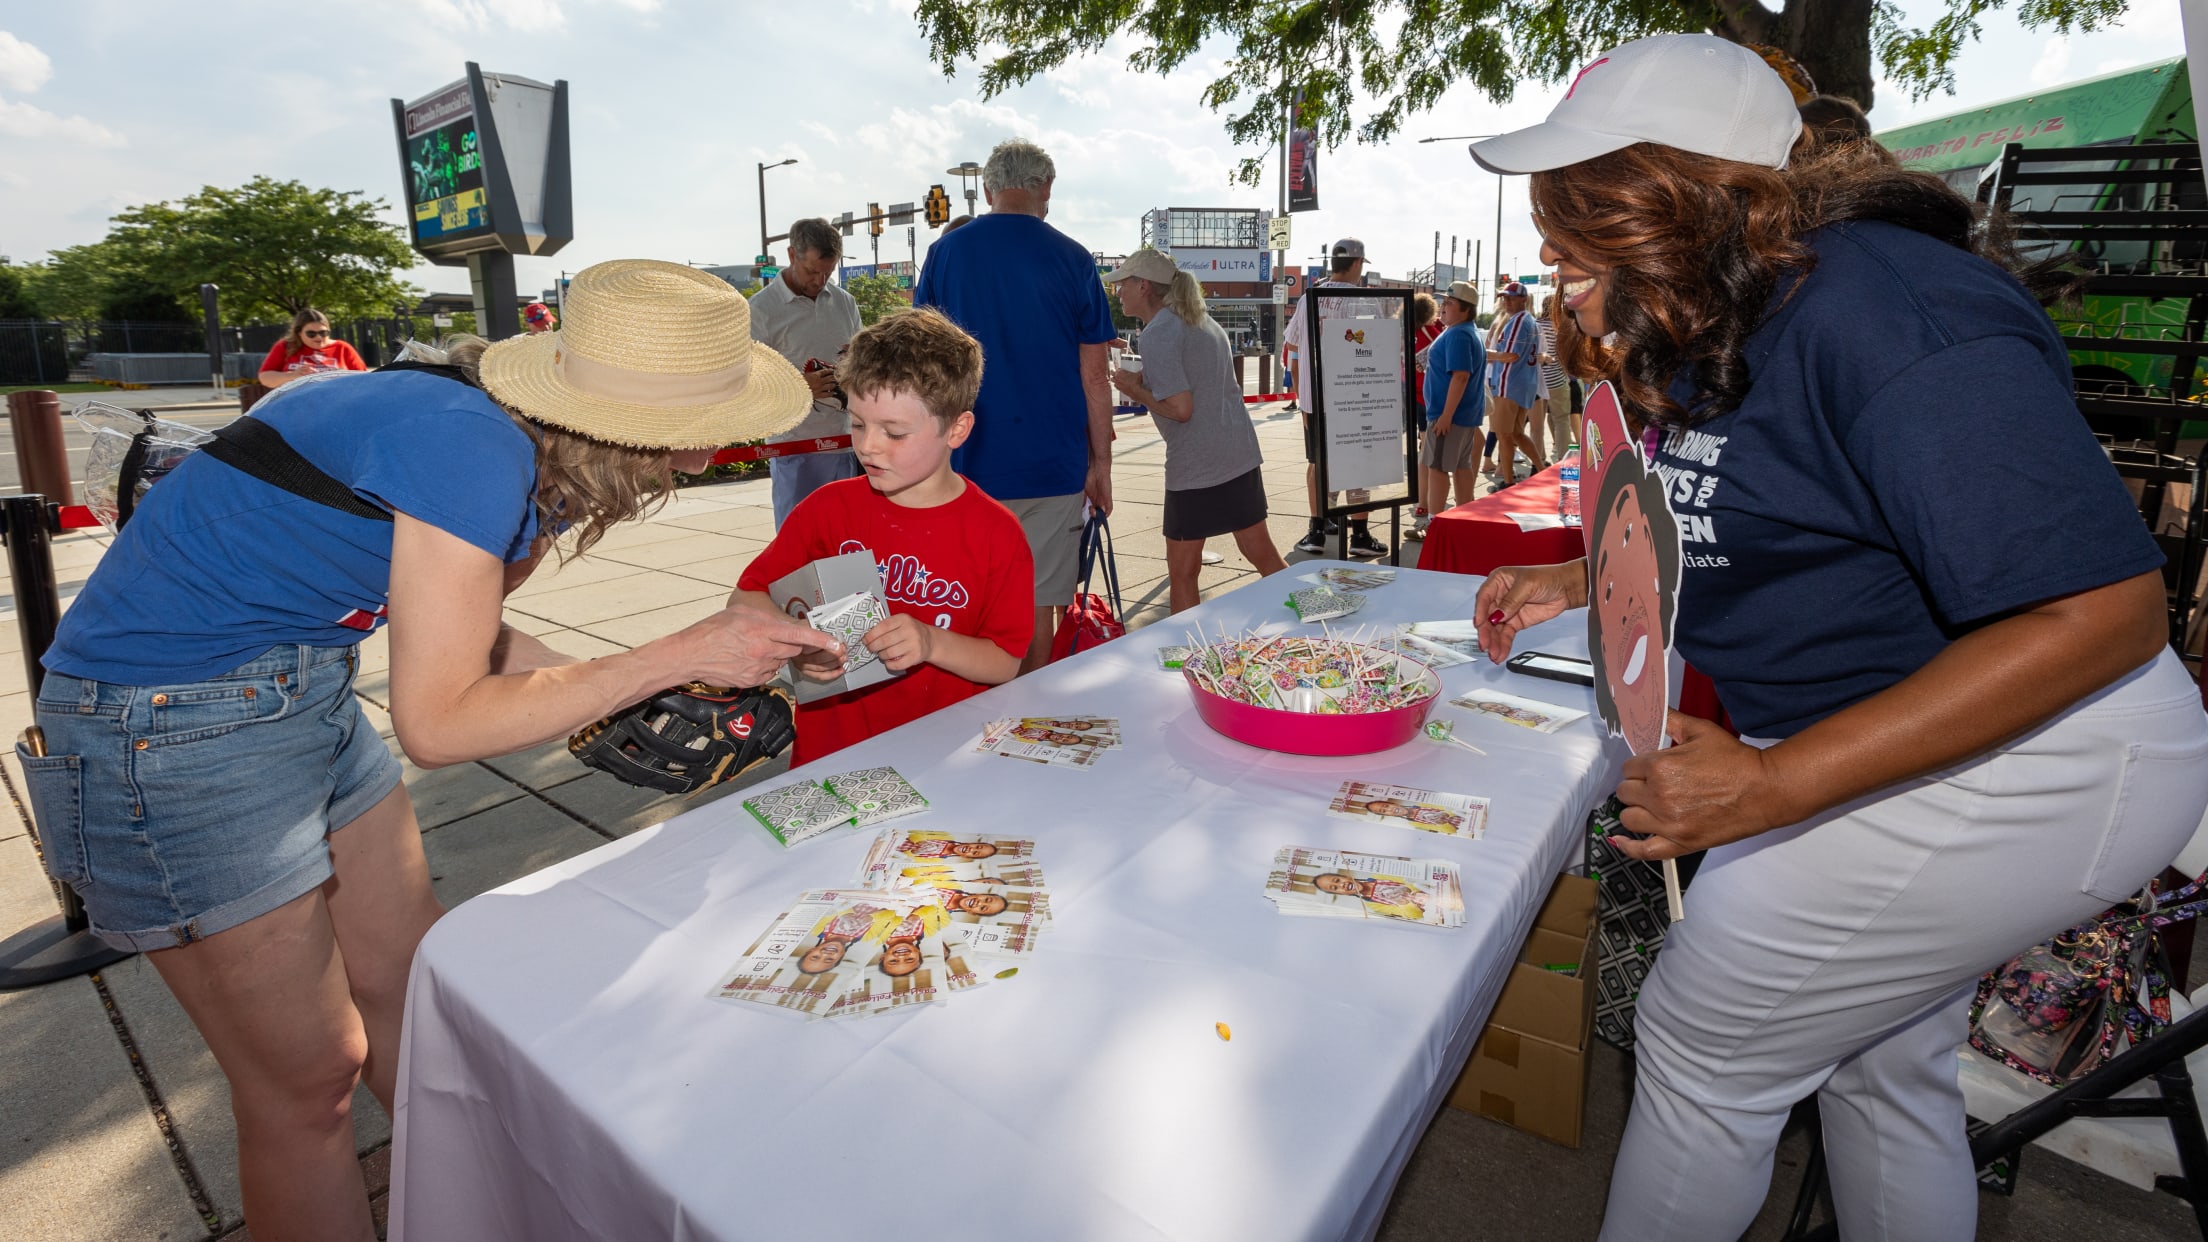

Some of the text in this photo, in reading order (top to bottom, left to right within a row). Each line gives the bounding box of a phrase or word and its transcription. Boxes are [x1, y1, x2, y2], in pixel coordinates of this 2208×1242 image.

[416, 106, 436, 127] Lincoln
[434, 94, 460, 119] Financial
[461, 131, 476, 152] GO
[457, 151, 480, 173] BIRDS
[1158, 222, 1168, 230] 95
[1219, 260, 1255, 270] ULTRA
[846, 267, 868, 277] xfinity
[1355, 348, 1373, 357] Menu
[815, 438, 839, 450] Phillies
[1694, 475, 1719, 508] FOR
[910, 986, 938, 995] Easy
